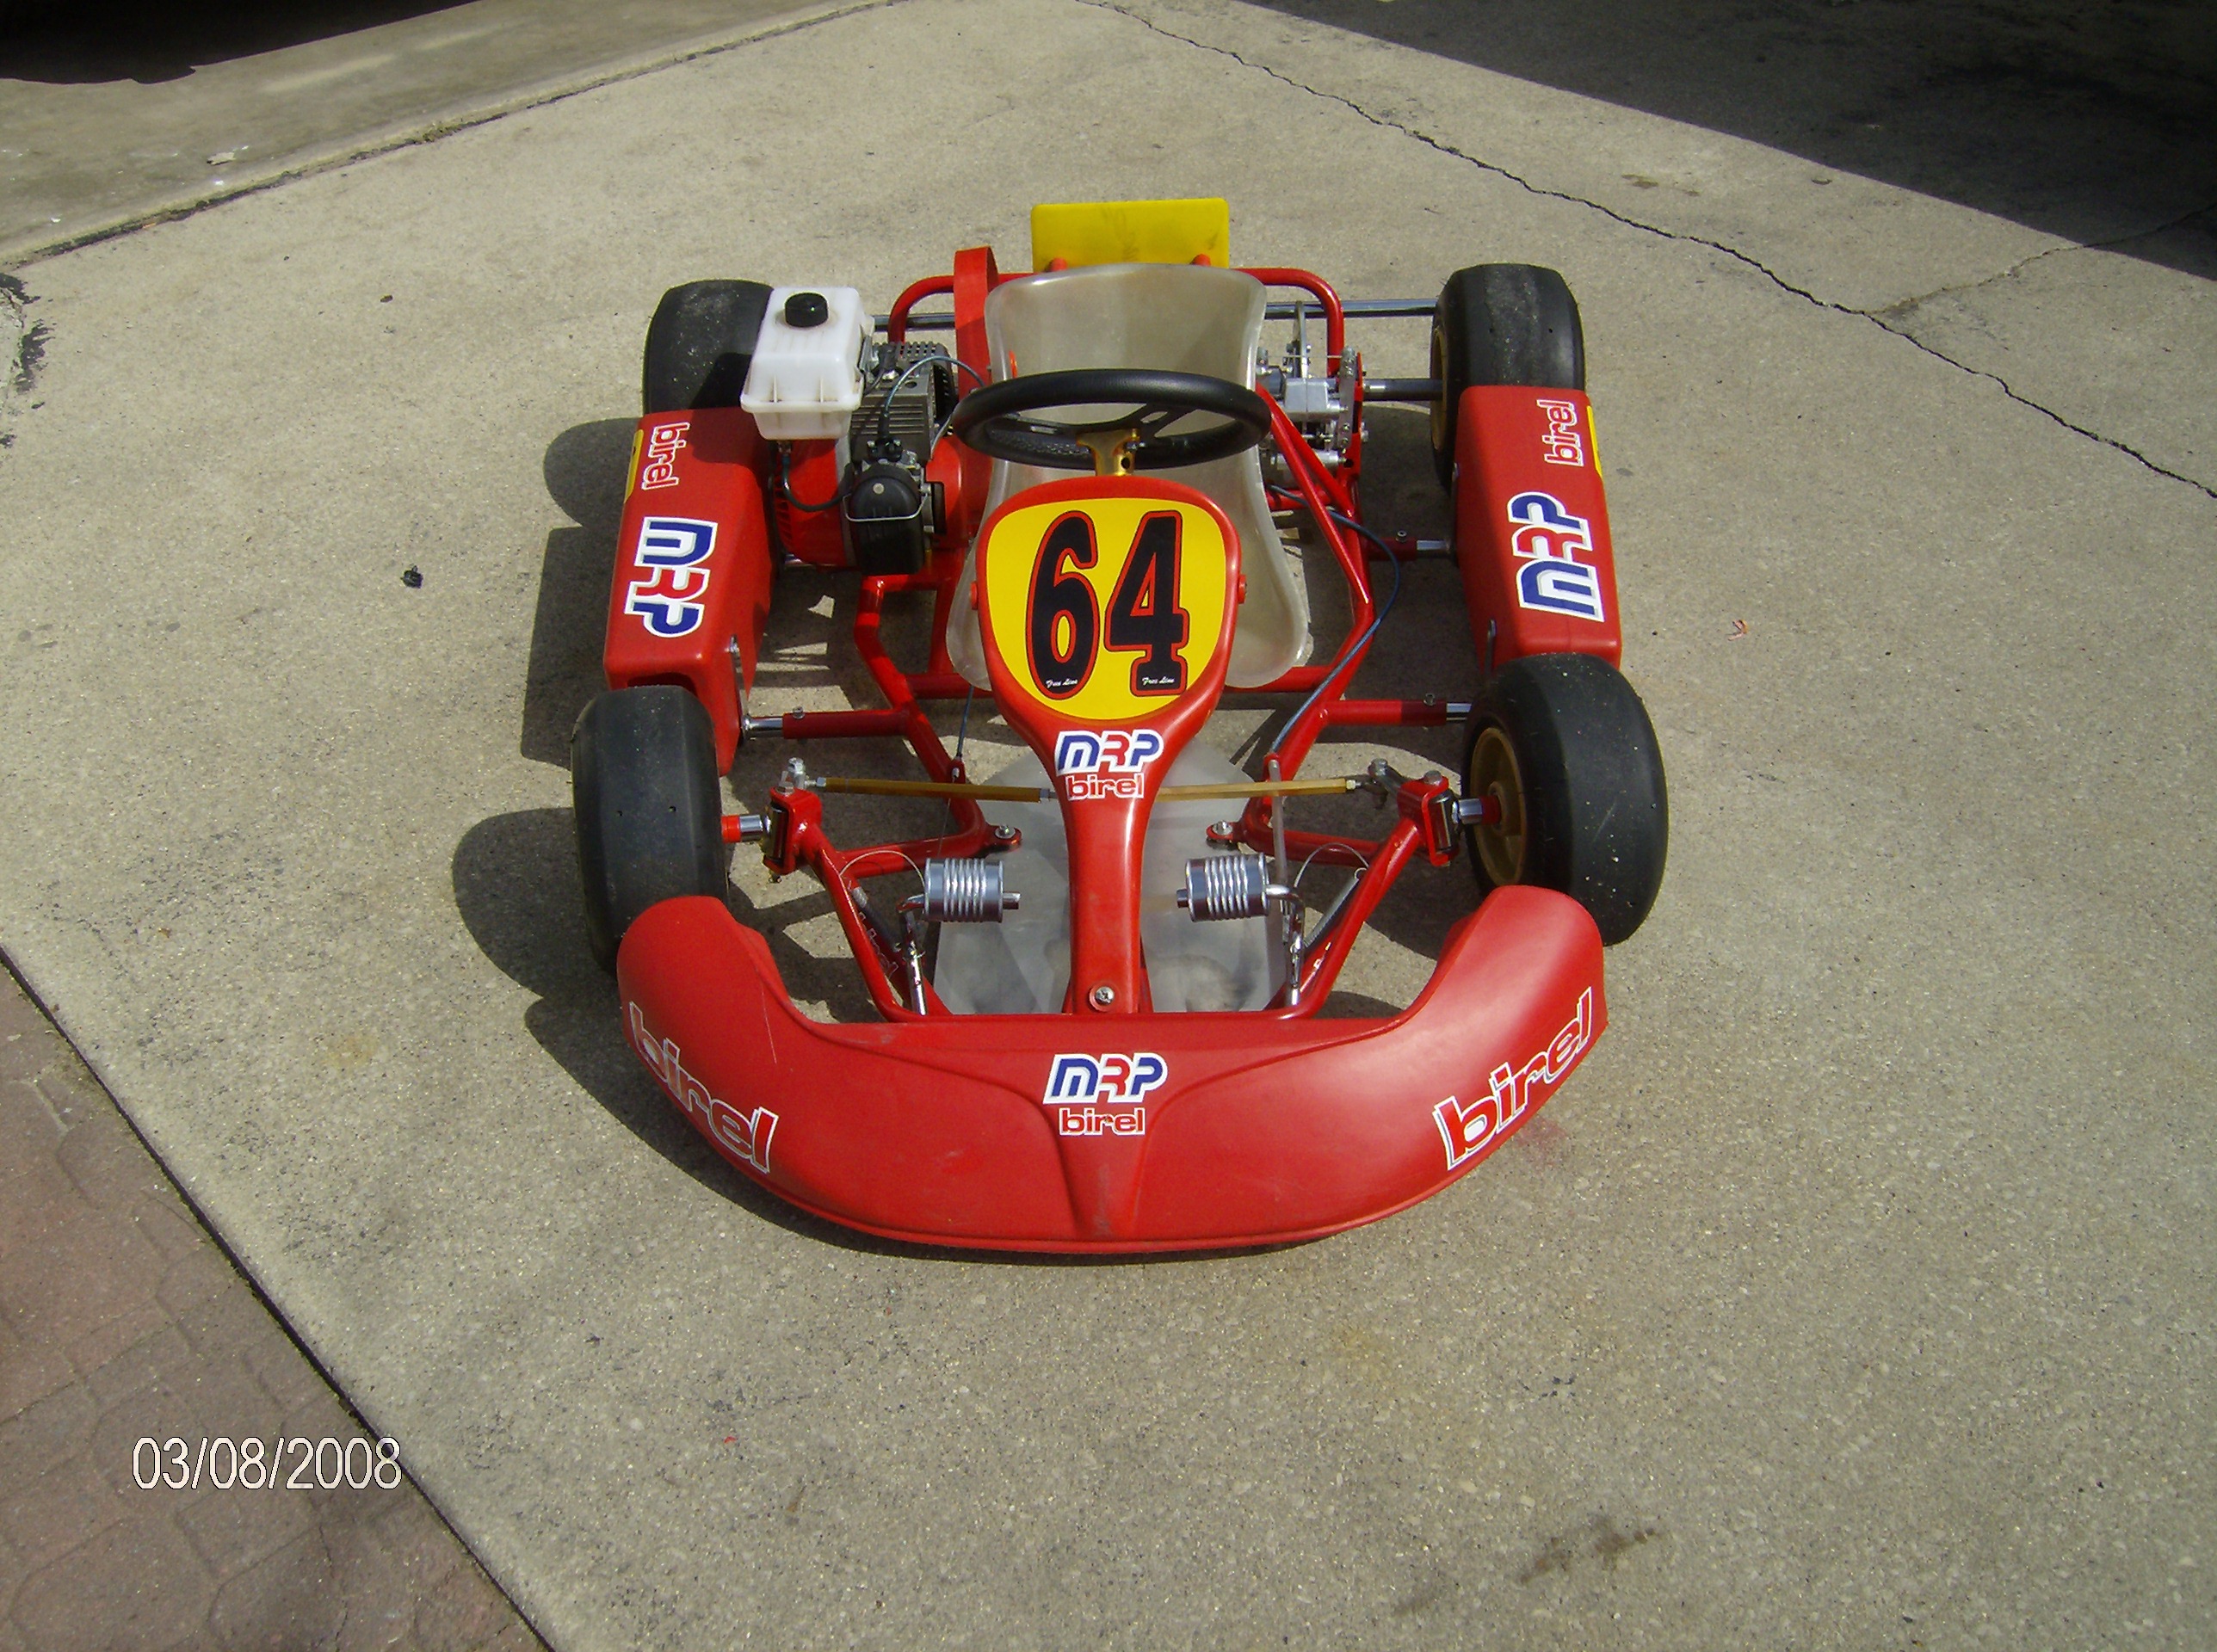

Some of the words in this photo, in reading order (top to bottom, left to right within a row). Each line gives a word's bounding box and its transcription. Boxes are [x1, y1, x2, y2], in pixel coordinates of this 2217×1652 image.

[641, 422, 690, 490] birel
[1536, 399, 1584, 466] birel
[624, 517, 719, 638] MRP
[1507, 491, 1604, 622] MRP
[1025, 510, 1190, 700] 64
[1054, 729, 1164, 777] MRP
[1065, 774, 1145, 801] birel
[629, 1002, 779, 1174] birel
[1043, 1052, 1169, 1104] MRP
[1432, 987, 1593, 1171] birel
[1059, 1107, 1146, 1136] birel
